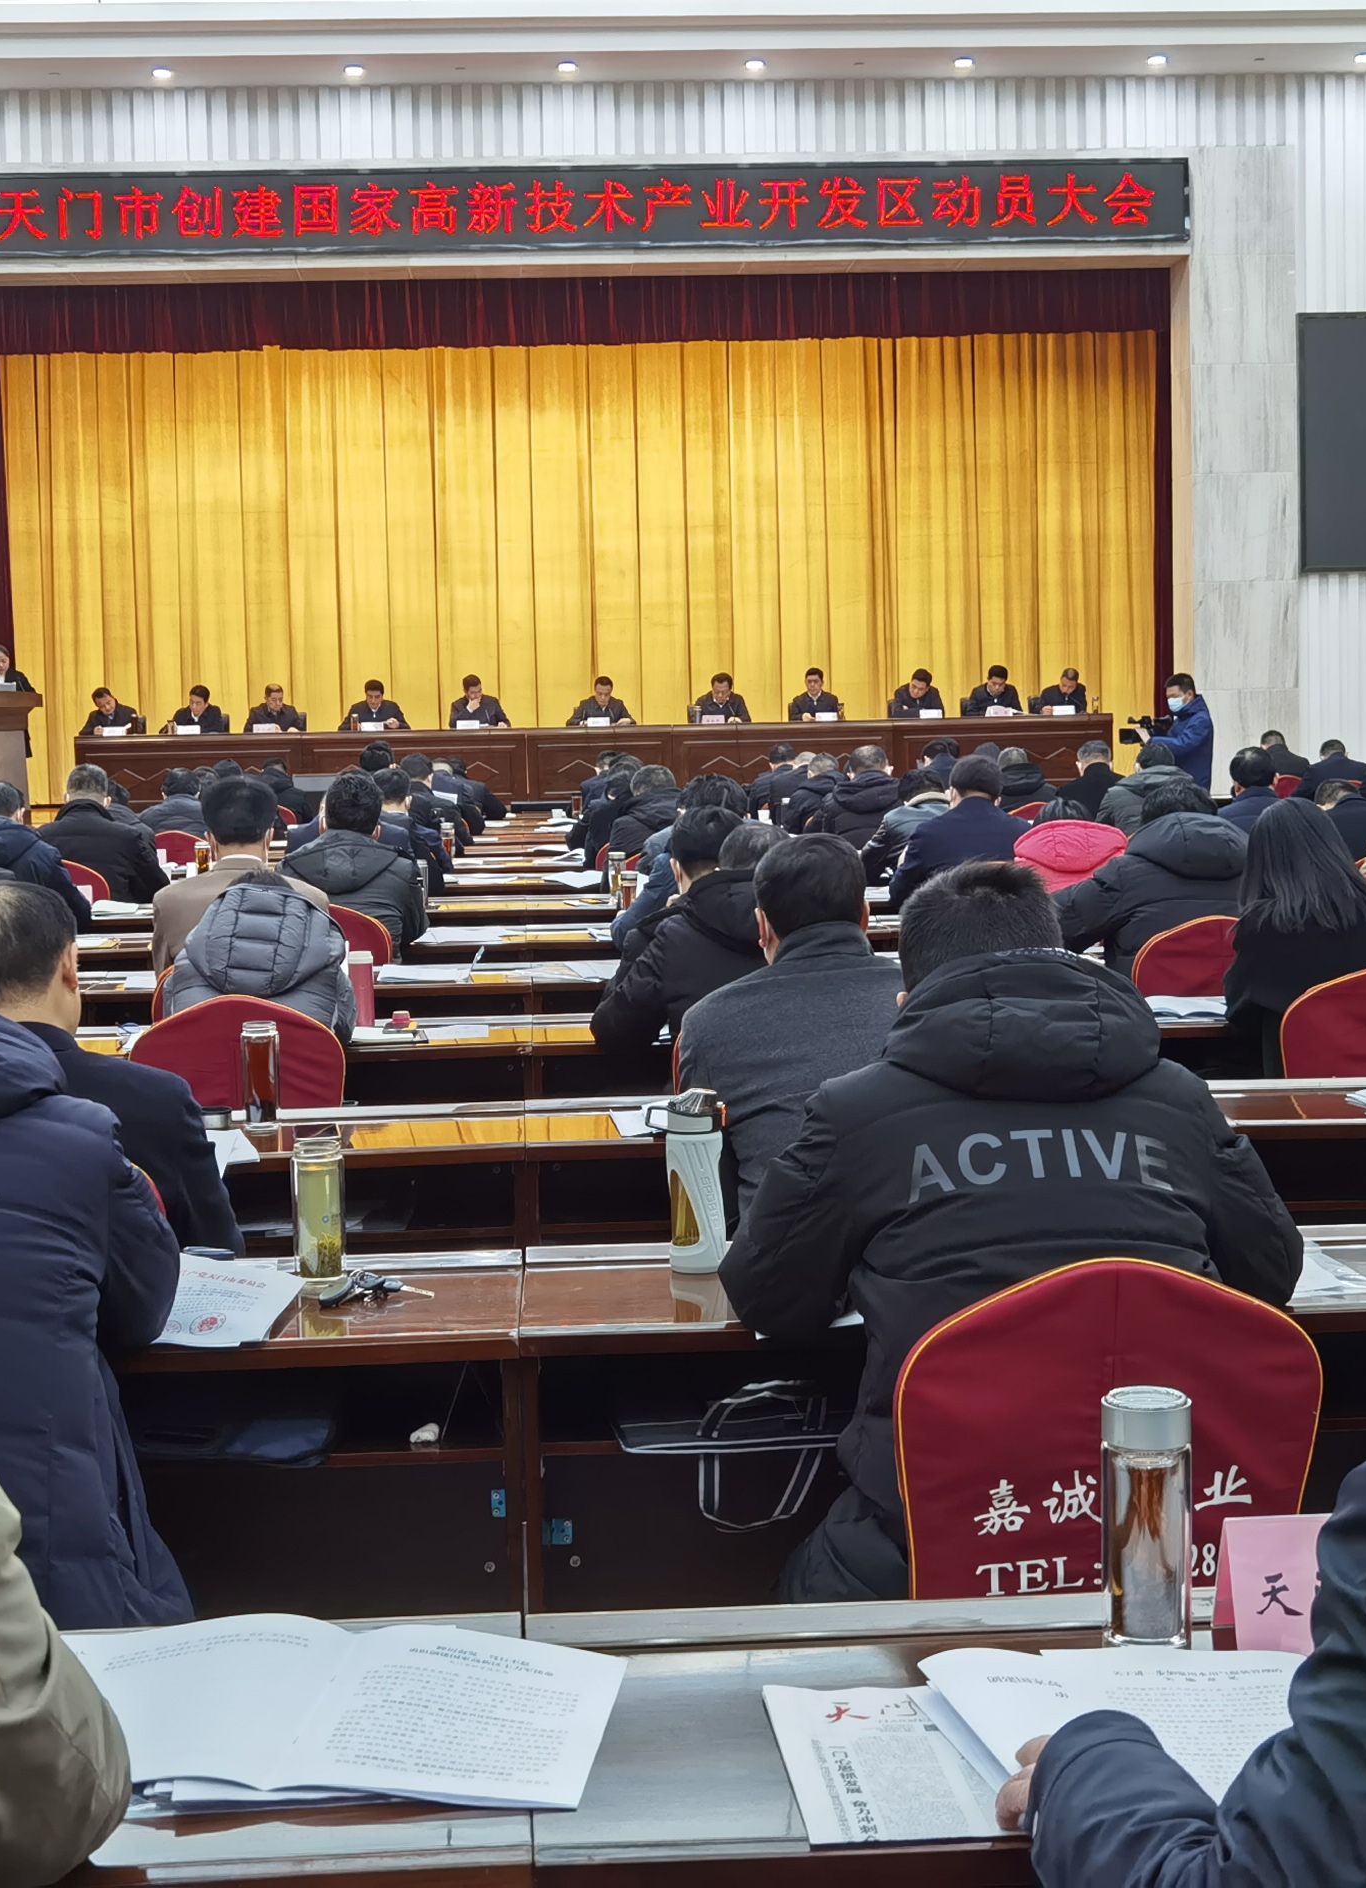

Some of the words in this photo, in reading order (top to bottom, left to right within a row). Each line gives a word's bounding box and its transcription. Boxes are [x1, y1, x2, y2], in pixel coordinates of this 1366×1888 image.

[908, 1128, 1174, 1205] ACTIVE
[974, 1463, 1253, 1537] 嘉诚业
[1256, 1571, 1322, 1617] 天
